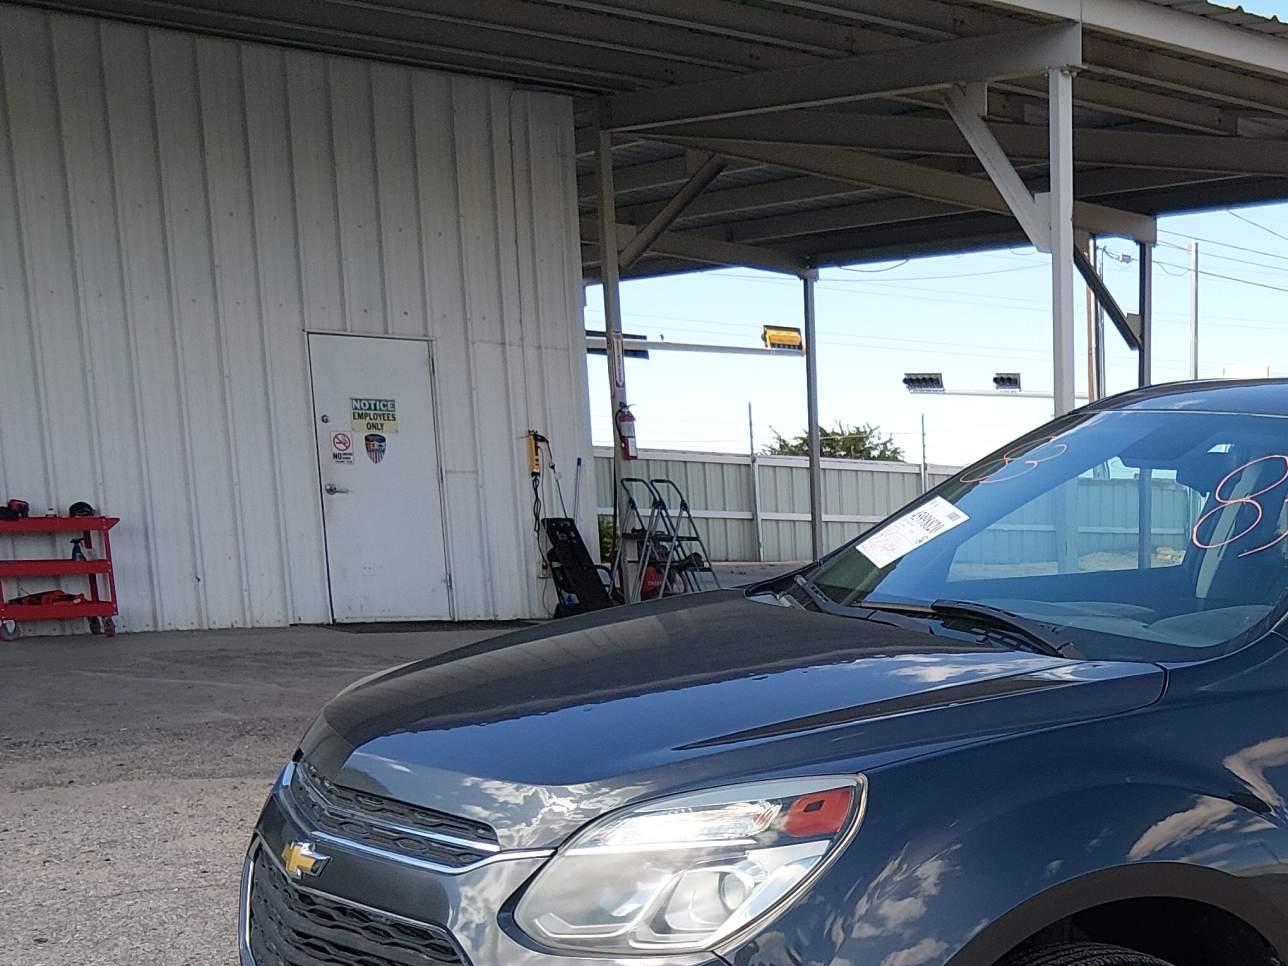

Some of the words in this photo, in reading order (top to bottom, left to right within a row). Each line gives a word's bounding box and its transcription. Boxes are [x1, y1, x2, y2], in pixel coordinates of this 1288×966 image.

[352, 399, 395, 411] NOTICE
[352, 411, 396, 421] EMPLOYEES
[366, 422, 385, 431] ONLY
[332, 452, 342, 460] NO
